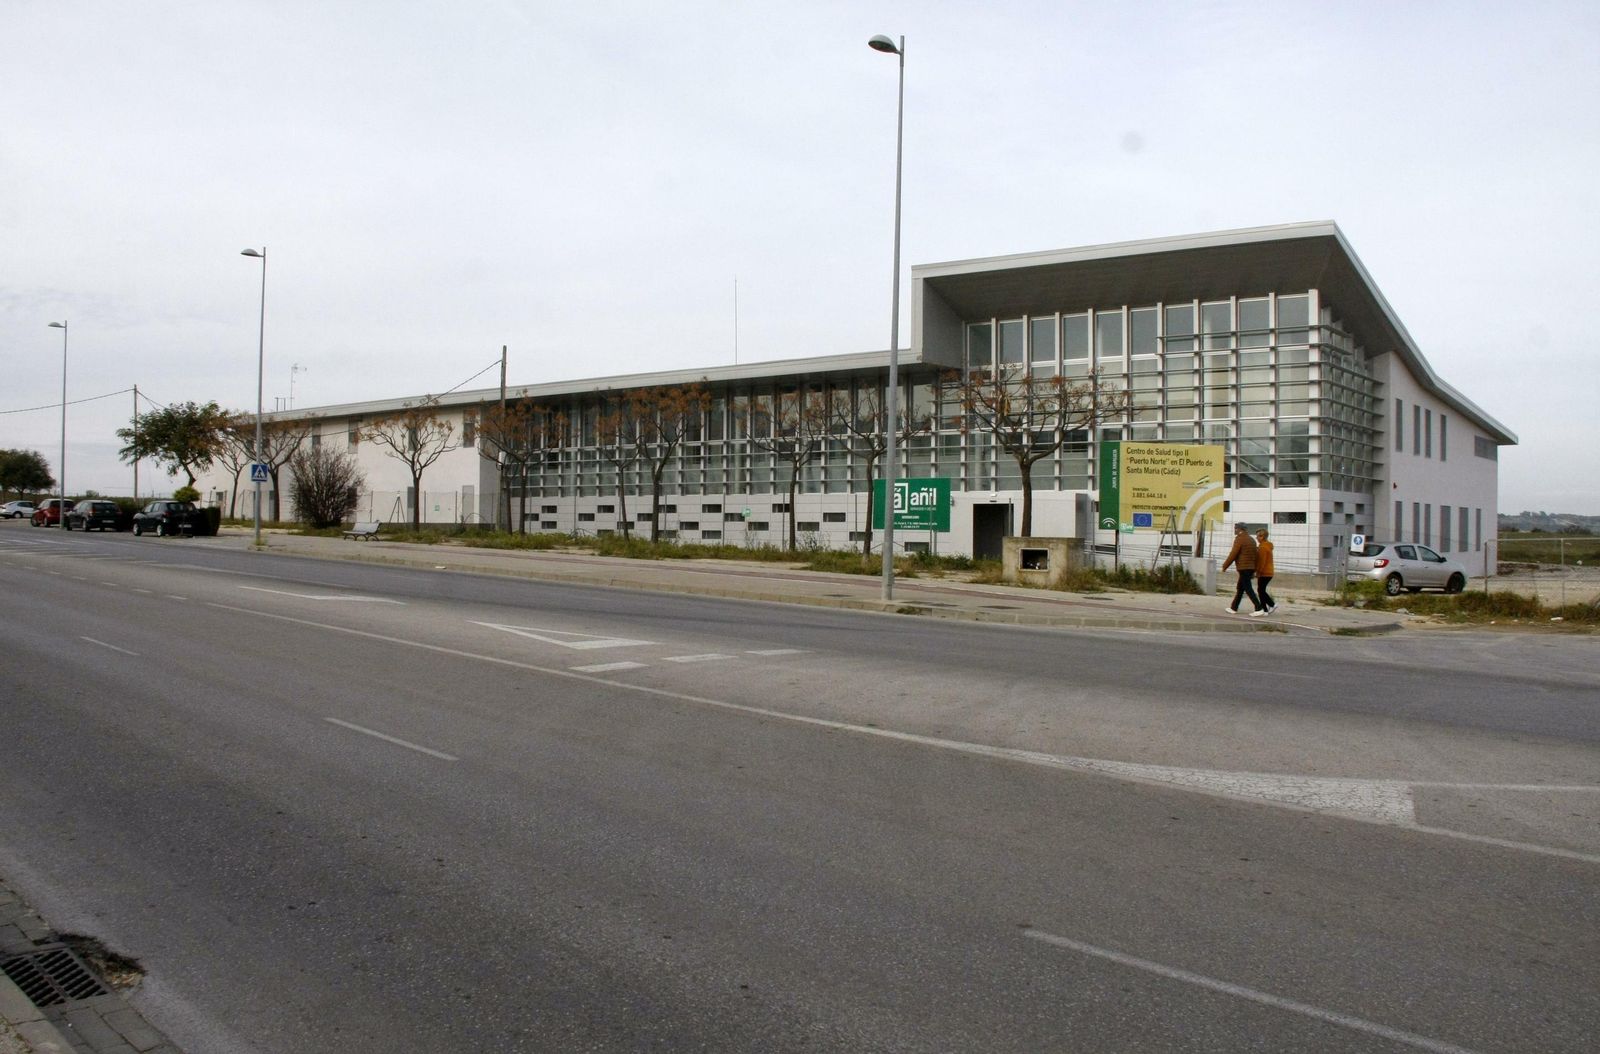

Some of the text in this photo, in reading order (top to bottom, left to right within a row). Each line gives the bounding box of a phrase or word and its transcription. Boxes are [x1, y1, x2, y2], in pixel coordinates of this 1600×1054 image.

[1126, 447, 1145, 455] Centro
[1155, 448, 1171, 456] Salud
[1172, 449, 1184, 457] tipo
[1179, 458, 1185, 466] El
[1126, 466, 1142, 474] Santa
[910, 487, 937, 506] añil
